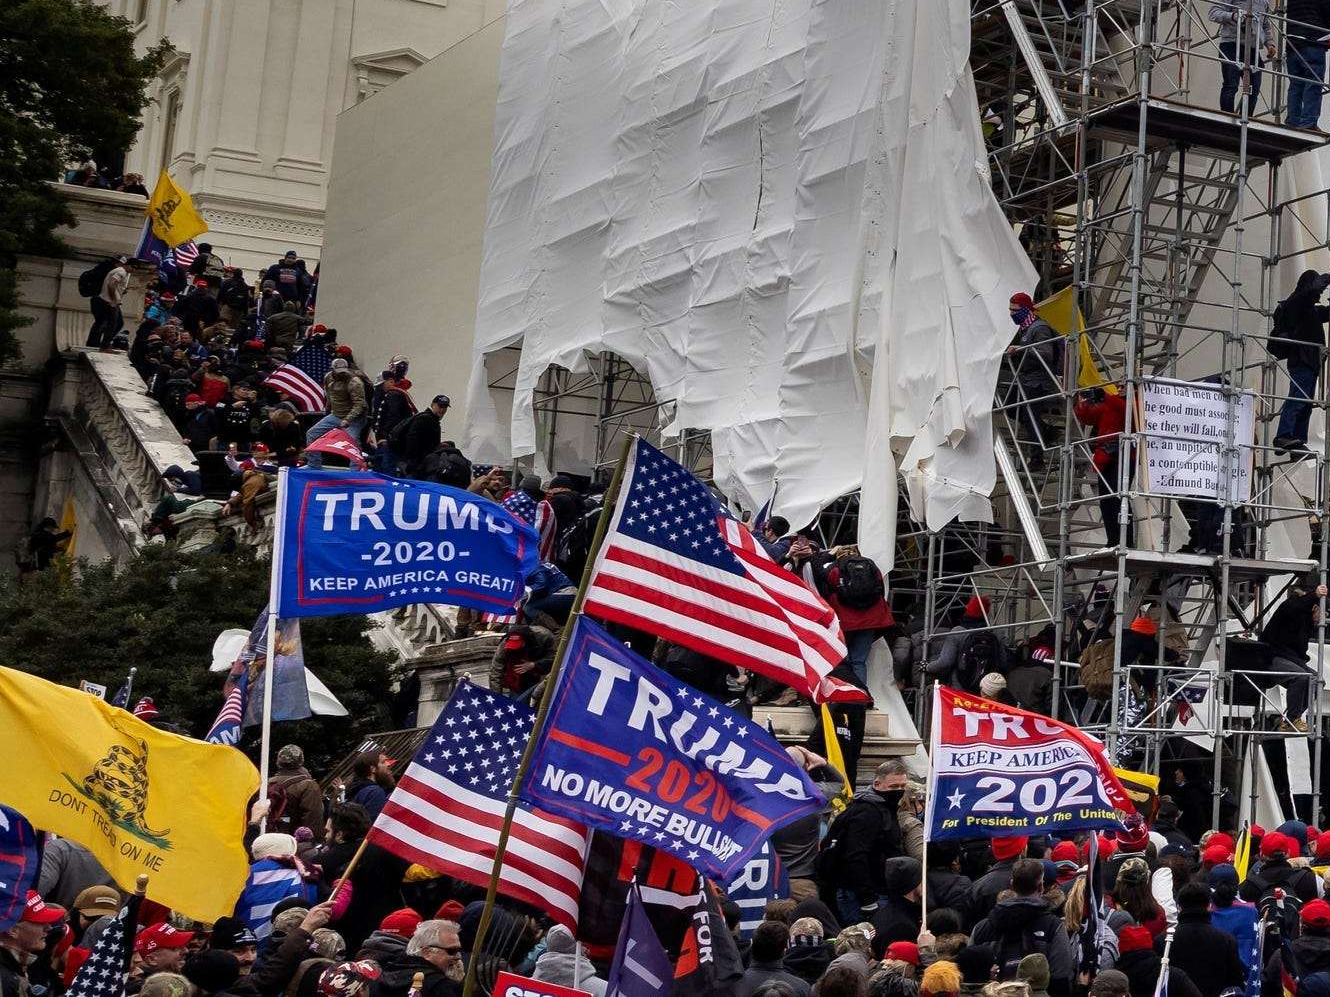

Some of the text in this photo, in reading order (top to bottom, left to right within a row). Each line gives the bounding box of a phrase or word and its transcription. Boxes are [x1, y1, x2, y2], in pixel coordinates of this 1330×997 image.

[1143, 382, 1171, 394] When
[1173, 387, 1190, 398] bad
[1192, 391, 1211, 401] men
[1159, 403, 1182, 415] good
[1184, 407, 1207, 418] must
[1145, 420, 1158, 431] lse
[1161, 419, 1181, 435] they
[1183, 423, 1200, 434] will
[1161, 441, 1174, 450] an
[1156, 475, 1203, 489] -Edmund
[361, 541, 470, 567] -2020-
[309, 569, 515, 594] KEEP AMERICA GREAT!
[587, 651, 808, 801] TRUMP
[953, 707, 1066, 740] TRU
[950, 746, 1080, 769] KEEP AMERIC
[541, 763, 583, 797] NO
[584, 779, 665, 828] MORE
[624, 746, 736, 824] 2020
[971, 769, 1112, 813] 202
[49, 788, 165, 874] DONT TREAD ON ME
[941, 819, 959, 830] For
[966, 816, 1028, 828] President
[1034, 815, 1050, 827] Of
[1052, 812, 1074, 823] The
